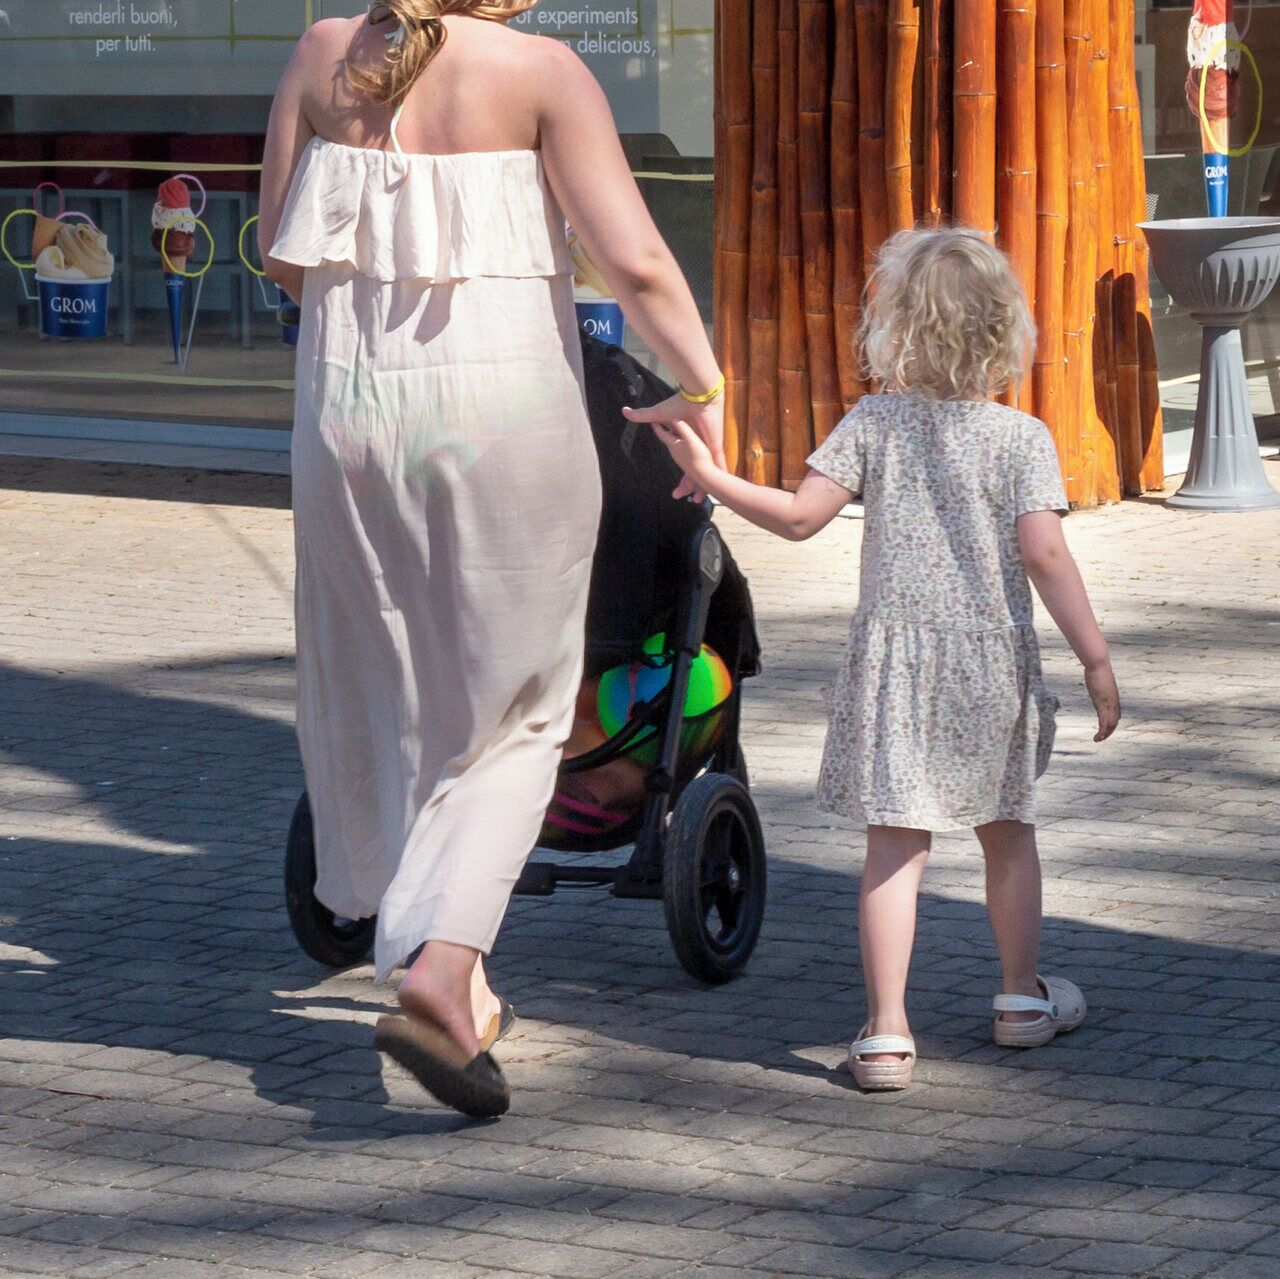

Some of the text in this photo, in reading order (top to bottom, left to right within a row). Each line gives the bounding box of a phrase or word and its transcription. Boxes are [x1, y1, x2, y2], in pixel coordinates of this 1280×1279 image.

[69, 2, 178, 28] renderli buoni,
[537, 4, 639, 30] experiments
[95, 33, 156, 57] per tutti.
[577, 30, 656, 57] delicious,
[1205, 165, 1228, 179] GROM
[50, 296, 97, 314] GROM
[583, 318, 612, 336] OM
